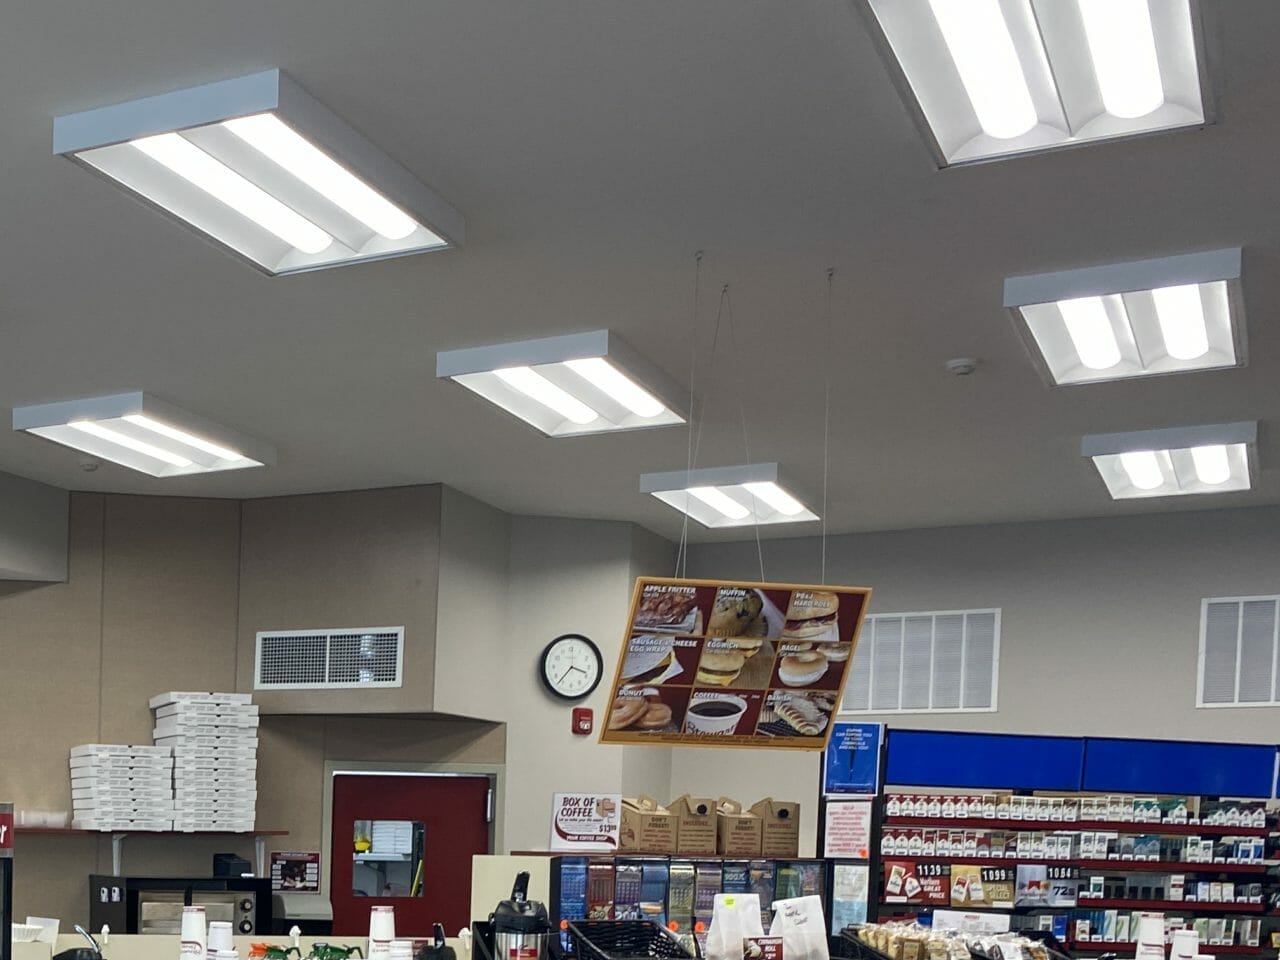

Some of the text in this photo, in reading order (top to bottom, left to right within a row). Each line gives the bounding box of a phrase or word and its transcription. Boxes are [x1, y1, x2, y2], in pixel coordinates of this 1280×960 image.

[720, 589, 746, 597] MUFFIN
[672, 639, 698, 647] CHEESE
[562, 797, 595, 807] BOX OF
[561, 808, 593, 817] COFFEE
